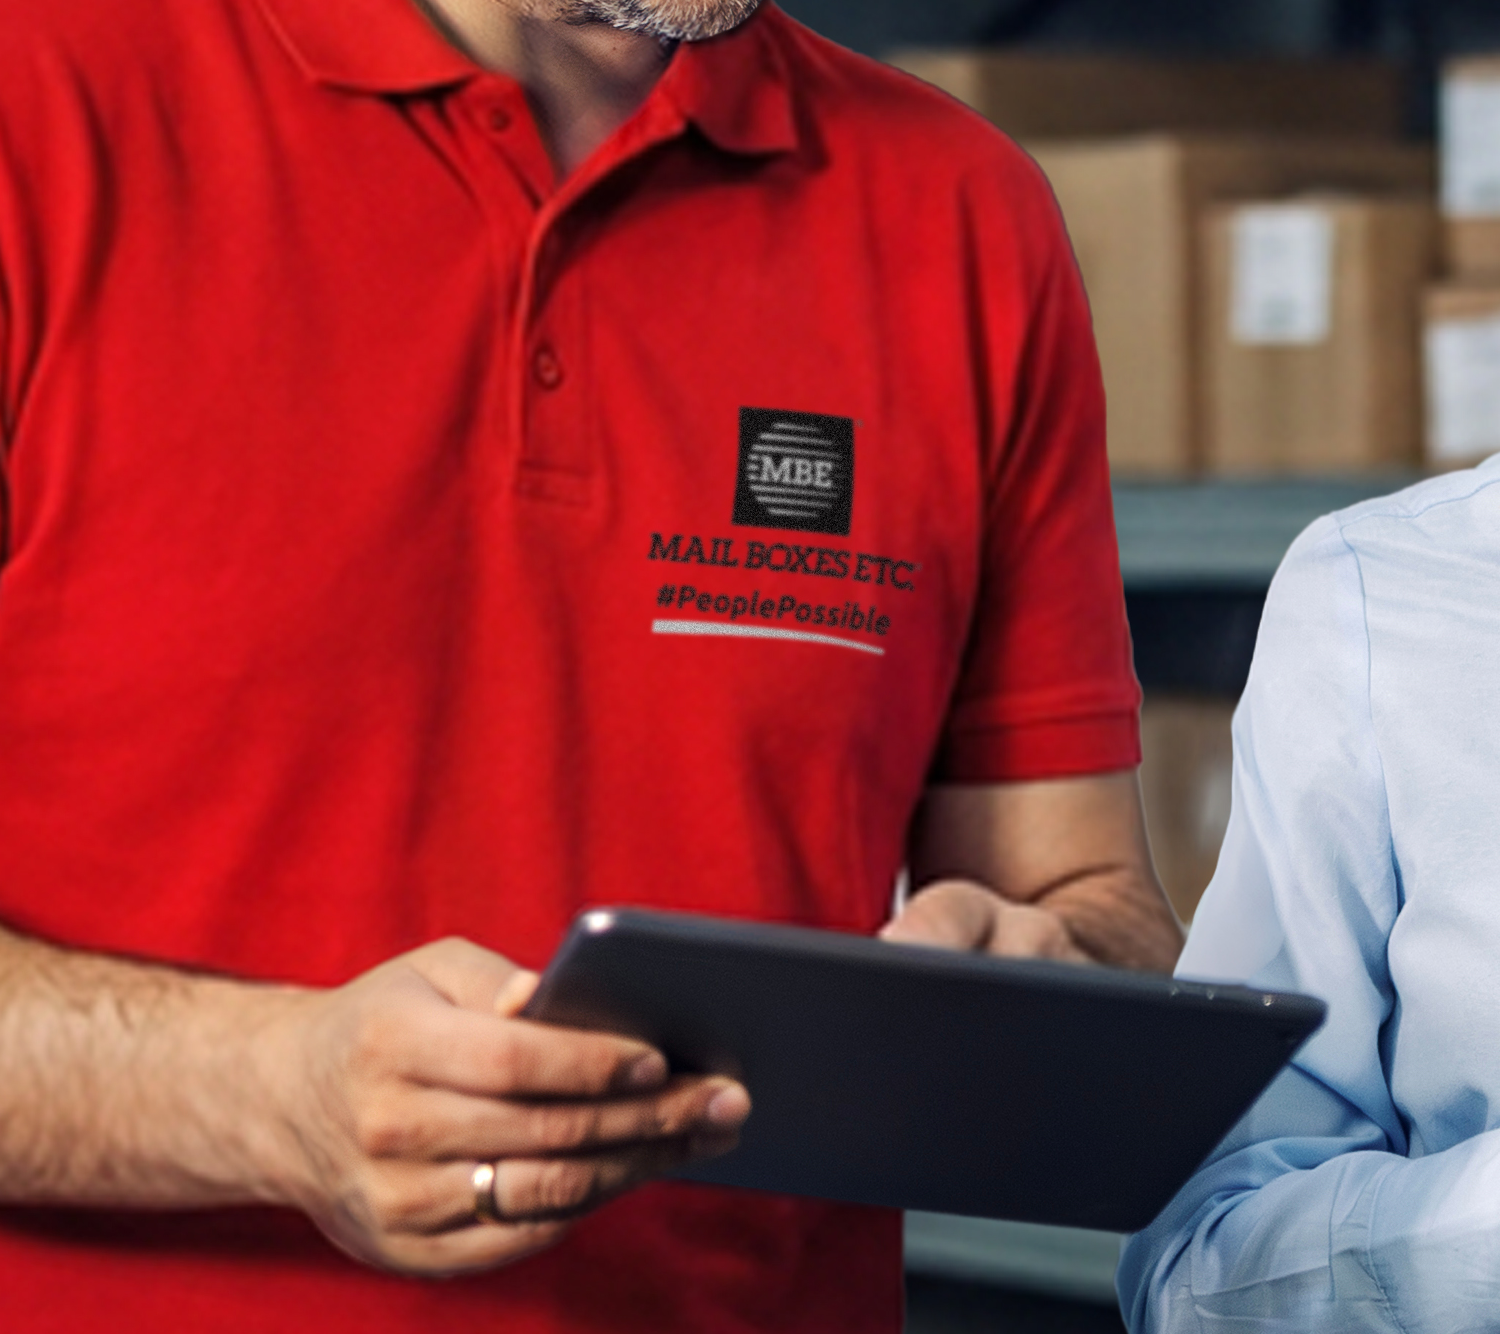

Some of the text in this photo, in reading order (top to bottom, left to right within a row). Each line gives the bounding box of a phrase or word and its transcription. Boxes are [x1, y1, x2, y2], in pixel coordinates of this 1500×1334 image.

[760, 455, 834, 488] MBE
[647, 532, 740, 568] MAIL
[743, 540, 852, 580] BOXES
[656, 583, 892, 637] #PeoplePossible
